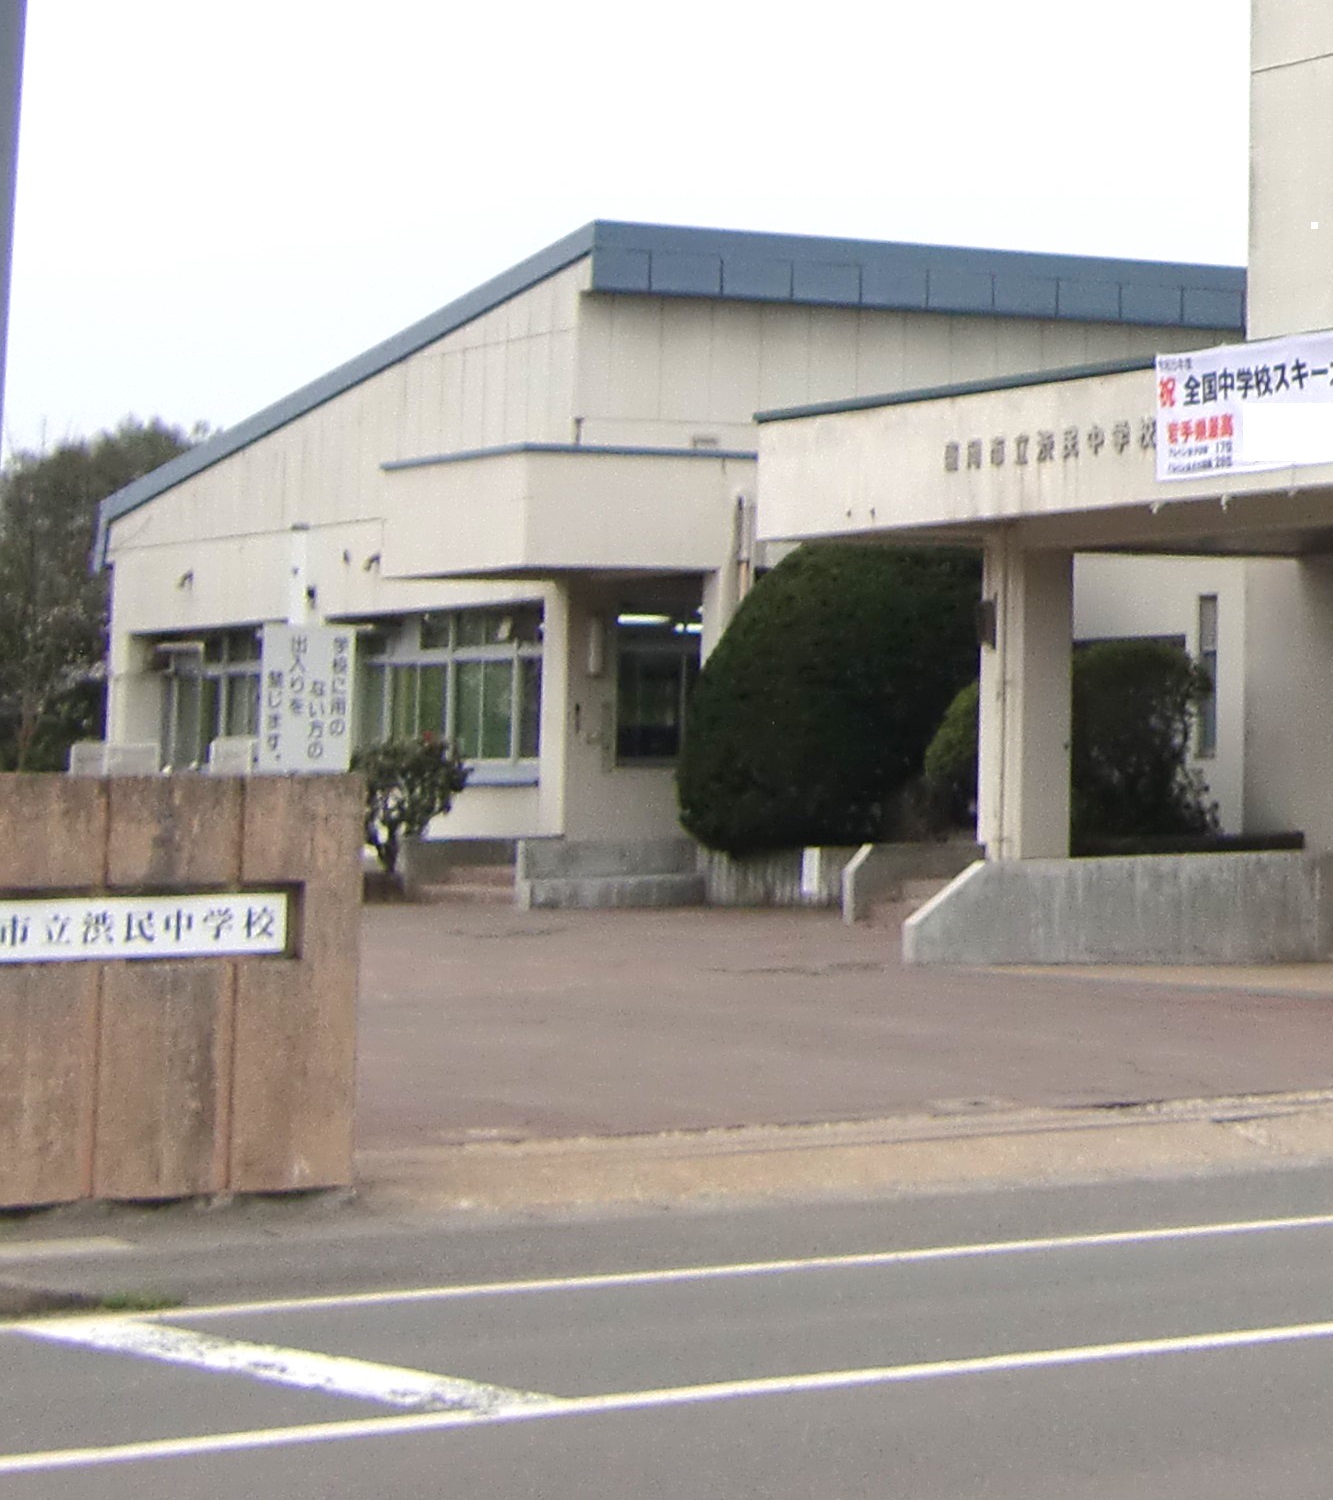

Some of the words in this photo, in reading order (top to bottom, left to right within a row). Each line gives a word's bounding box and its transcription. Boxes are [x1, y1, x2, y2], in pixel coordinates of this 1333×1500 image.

[0, 906, 275, 947] 市立渋民中学校
